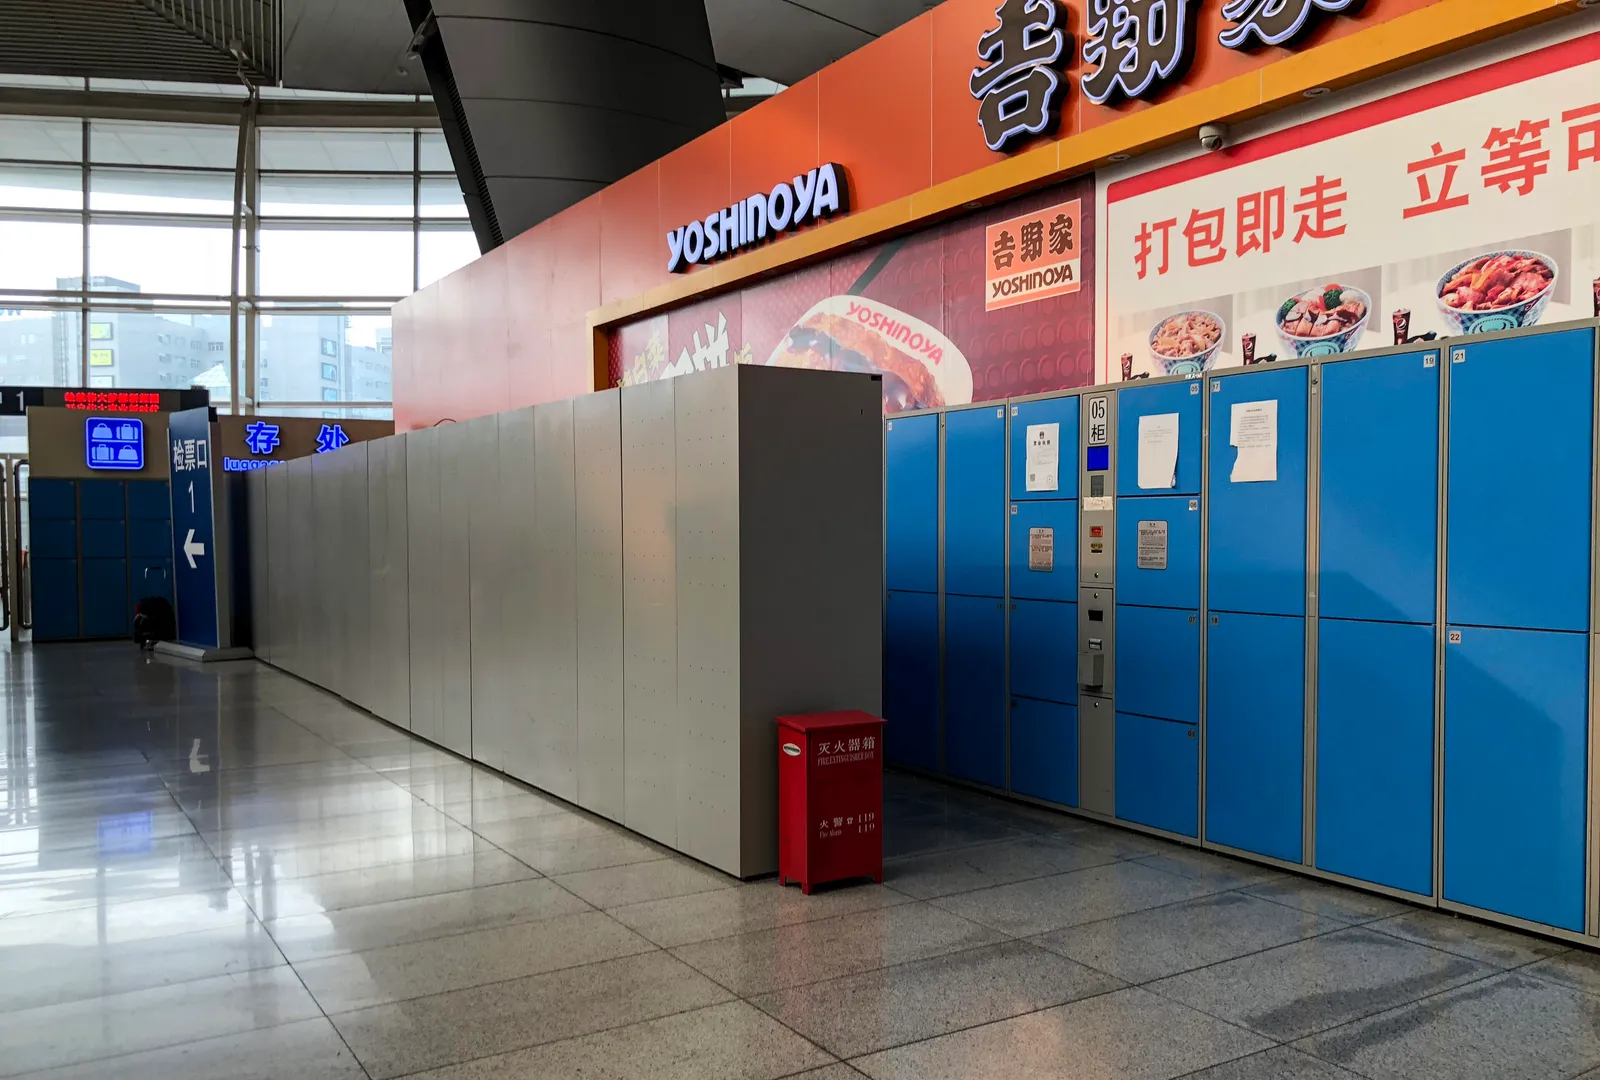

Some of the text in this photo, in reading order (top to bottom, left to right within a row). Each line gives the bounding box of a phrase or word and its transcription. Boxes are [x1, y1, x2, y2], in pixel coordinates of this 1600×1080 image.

[970, 0, 1356, 151] 吉野
[667, 163, 839, 273] YOSHINOYA
[1134, 175, 1348, 280] 打包即走
[993, 213, 1074, 271] 吉野家
[992, 264, 1073, 298] YOSHINOYA
[846, 301, 944, 366] YOSHINOYA
[1454, 353, 1464, 361] 21
[1091, 400, 1105, 419] 05
[1091, 424, 1105, 442] 柜
[173, 439, 208, 472] 检票口
[188, 480, 195, 513] 1
[817, 756, 829, 766] FIRE
[818, 736, 875, 755] 灭火器箱
[819, 812, 875, 830] 火警 119
[858, 823, 875, 833] 119
